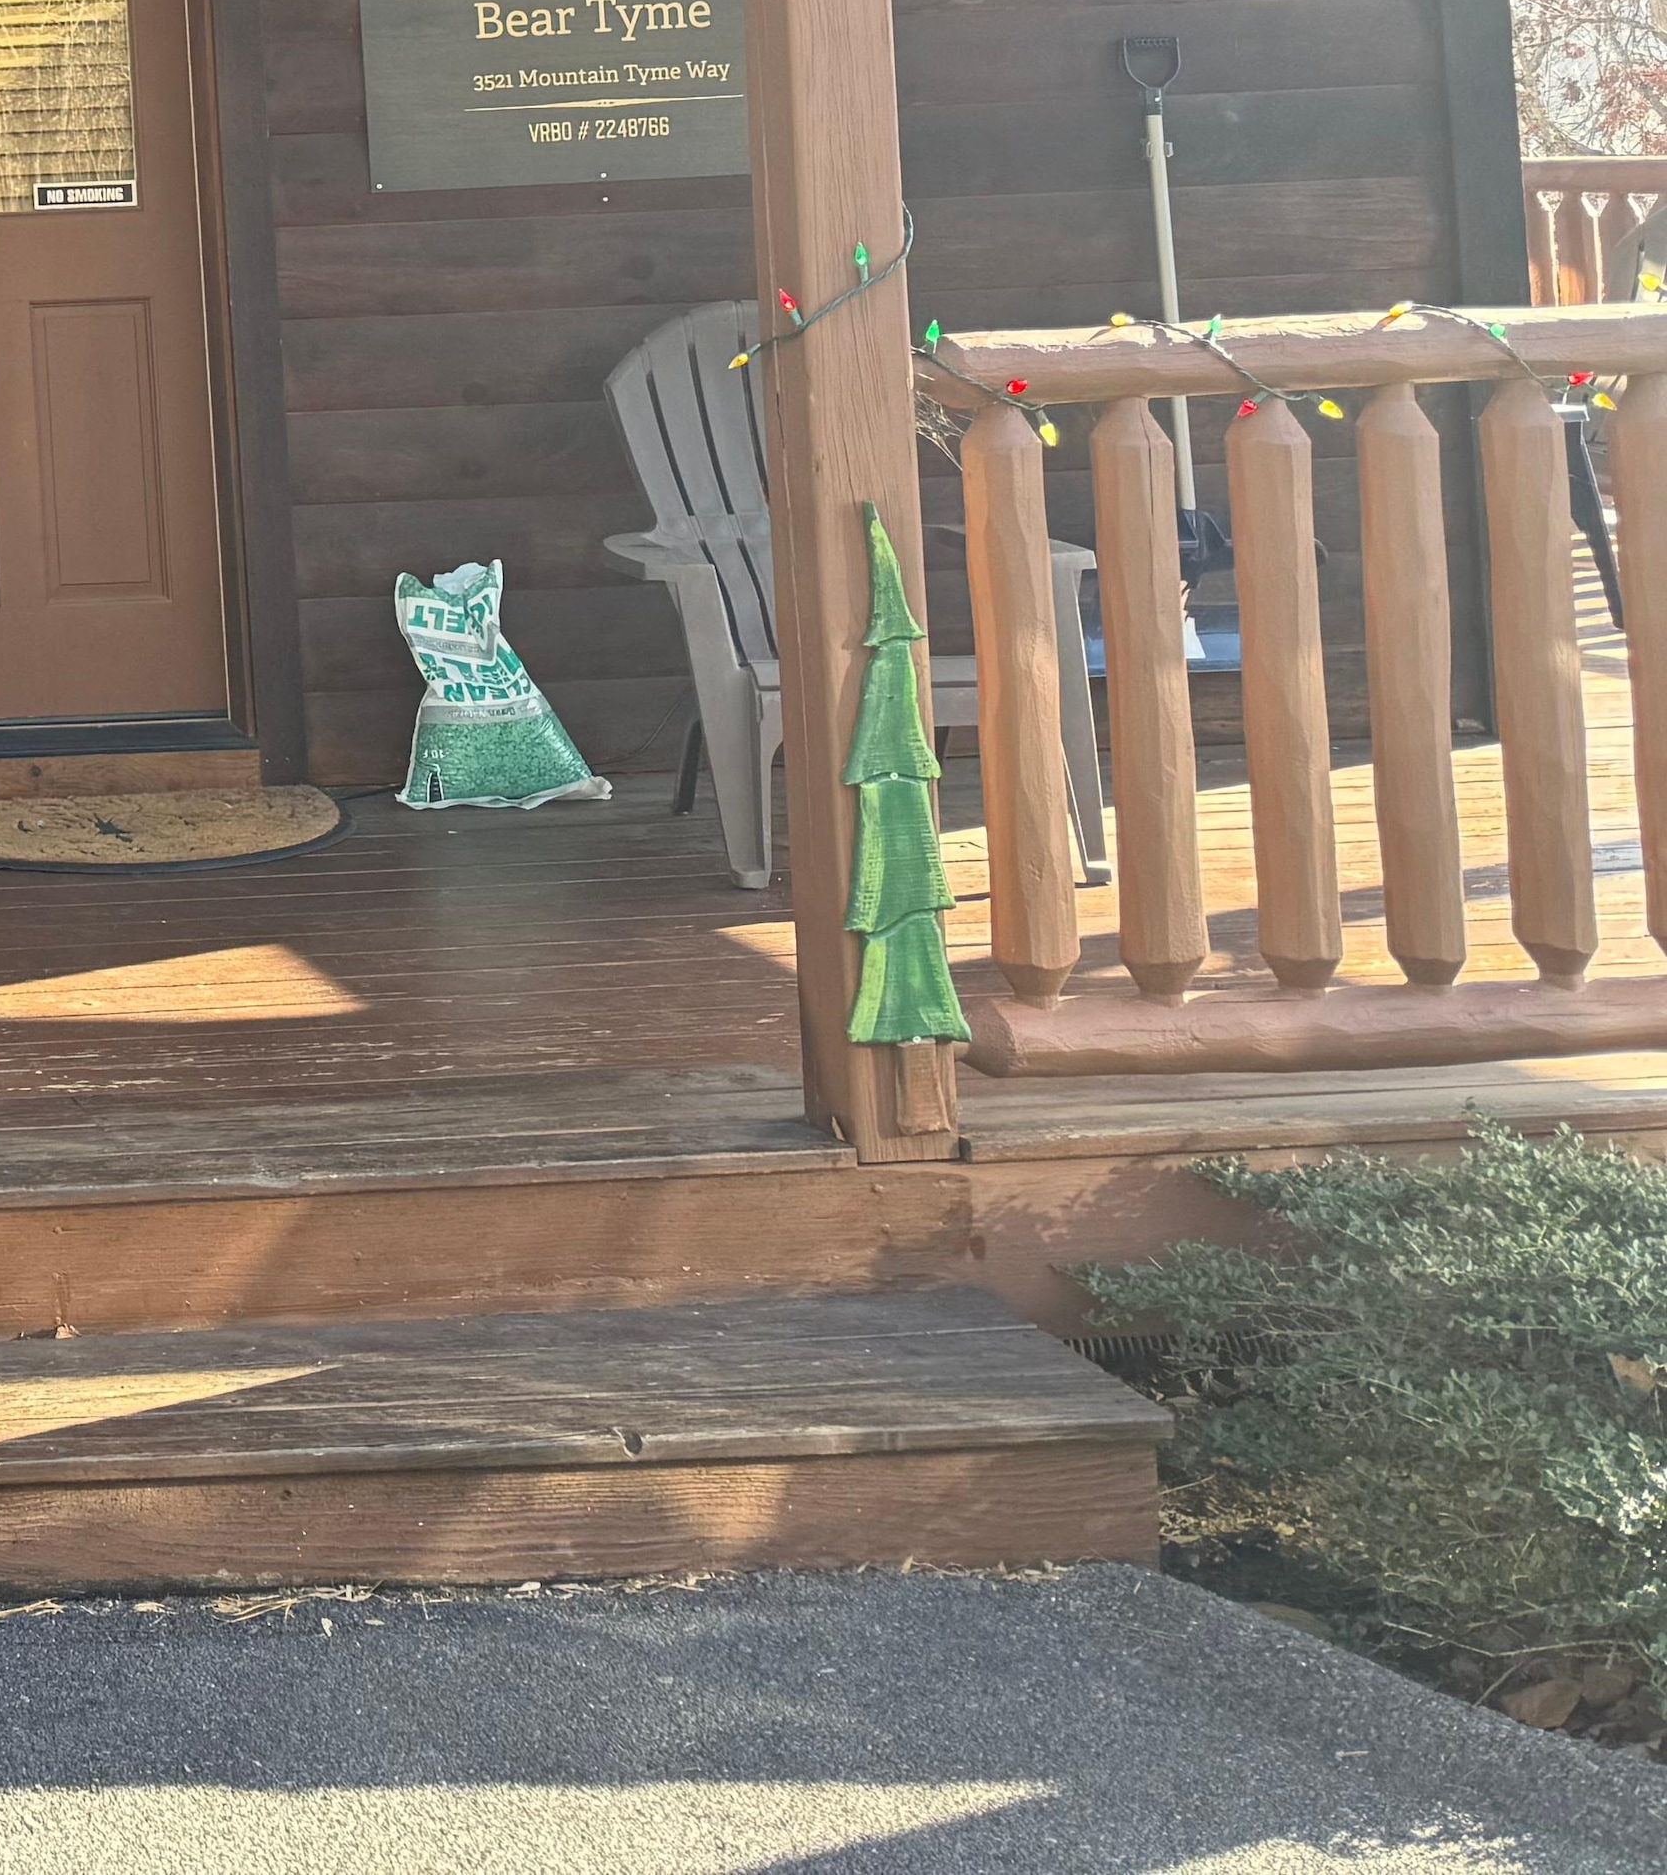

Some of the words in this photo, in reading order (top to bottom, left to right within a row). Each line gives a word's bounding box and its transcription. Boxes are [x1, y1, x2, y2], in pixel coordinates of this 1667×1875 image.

[473, 1, 576, 39] Bear
[472, 73, 514, 92] 3521
[518, 65, 620, 88] Mountain
[623, 63, 682, 86] Tyme
[685, 60, 731, 82] Way
[528, 121, 573, 143] VRBO
[577, 120, 590, 141] #
[594, 116, 670, 140] 2248766
[46, 188, 65, 205] NO
[66, 186, 125, 204] SMOKING
